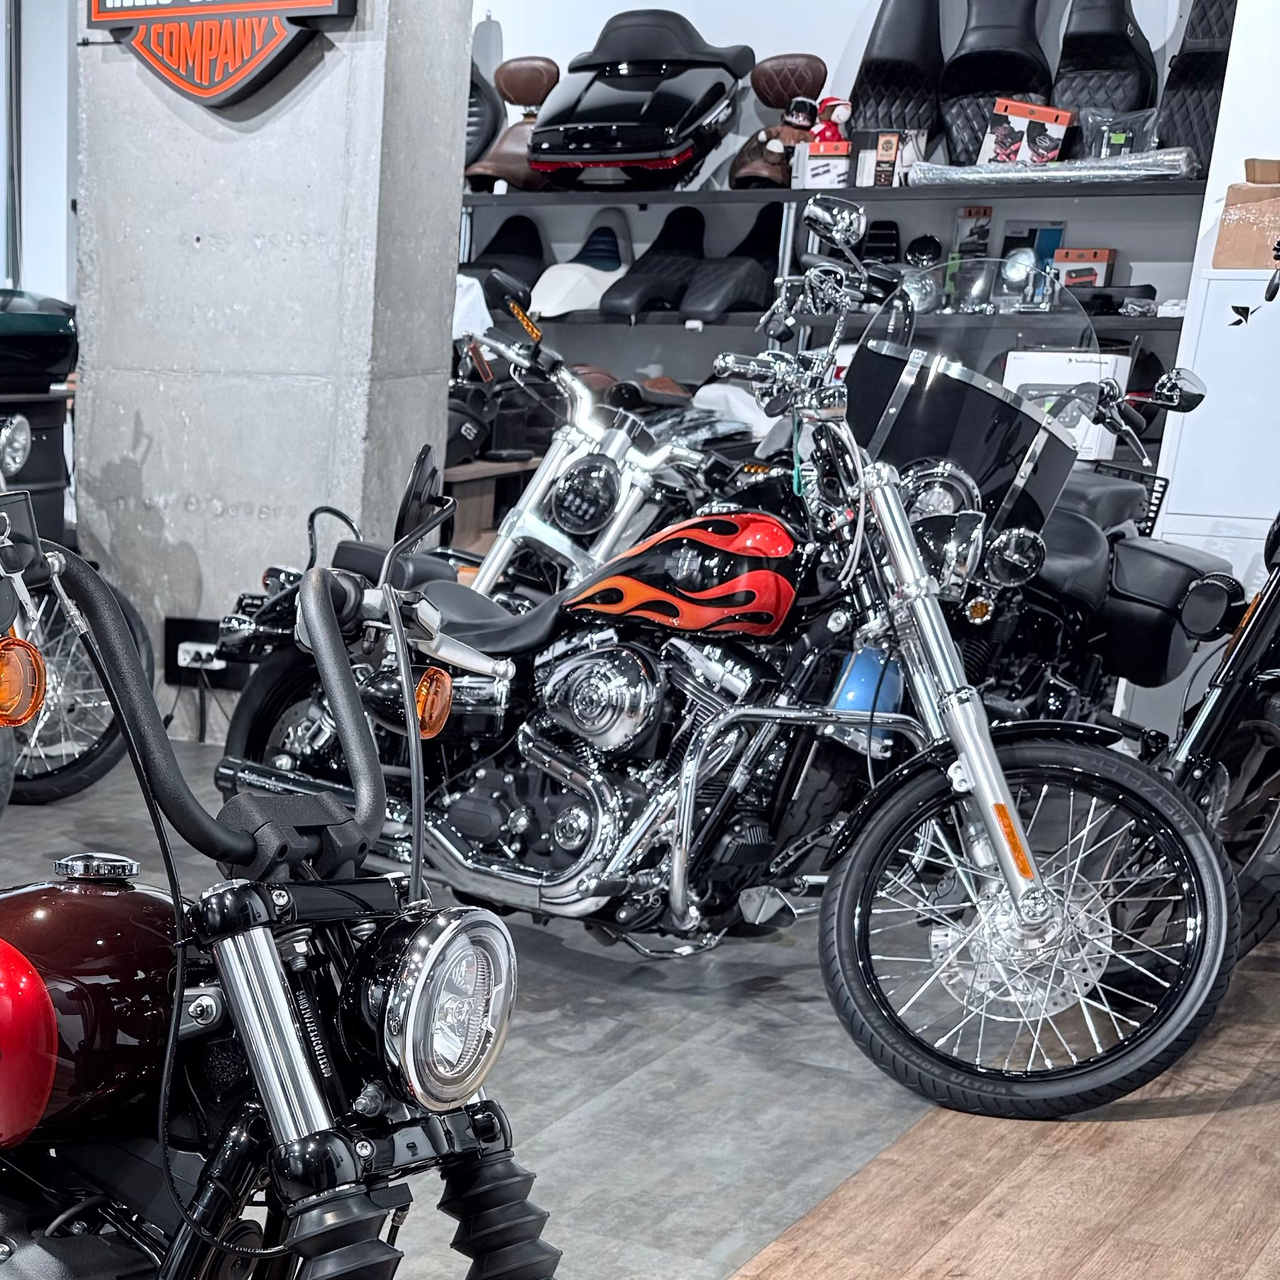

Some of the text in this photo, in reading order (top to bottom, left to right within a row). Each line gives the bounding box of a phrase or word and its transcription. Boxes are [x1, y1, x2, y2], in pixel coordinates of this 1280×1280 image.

[151, 16, 269, 86] COMPANY
[867, 1012, 943, 1075] MARATHON
[949, 1073, 1007, 1095] ULTRA
